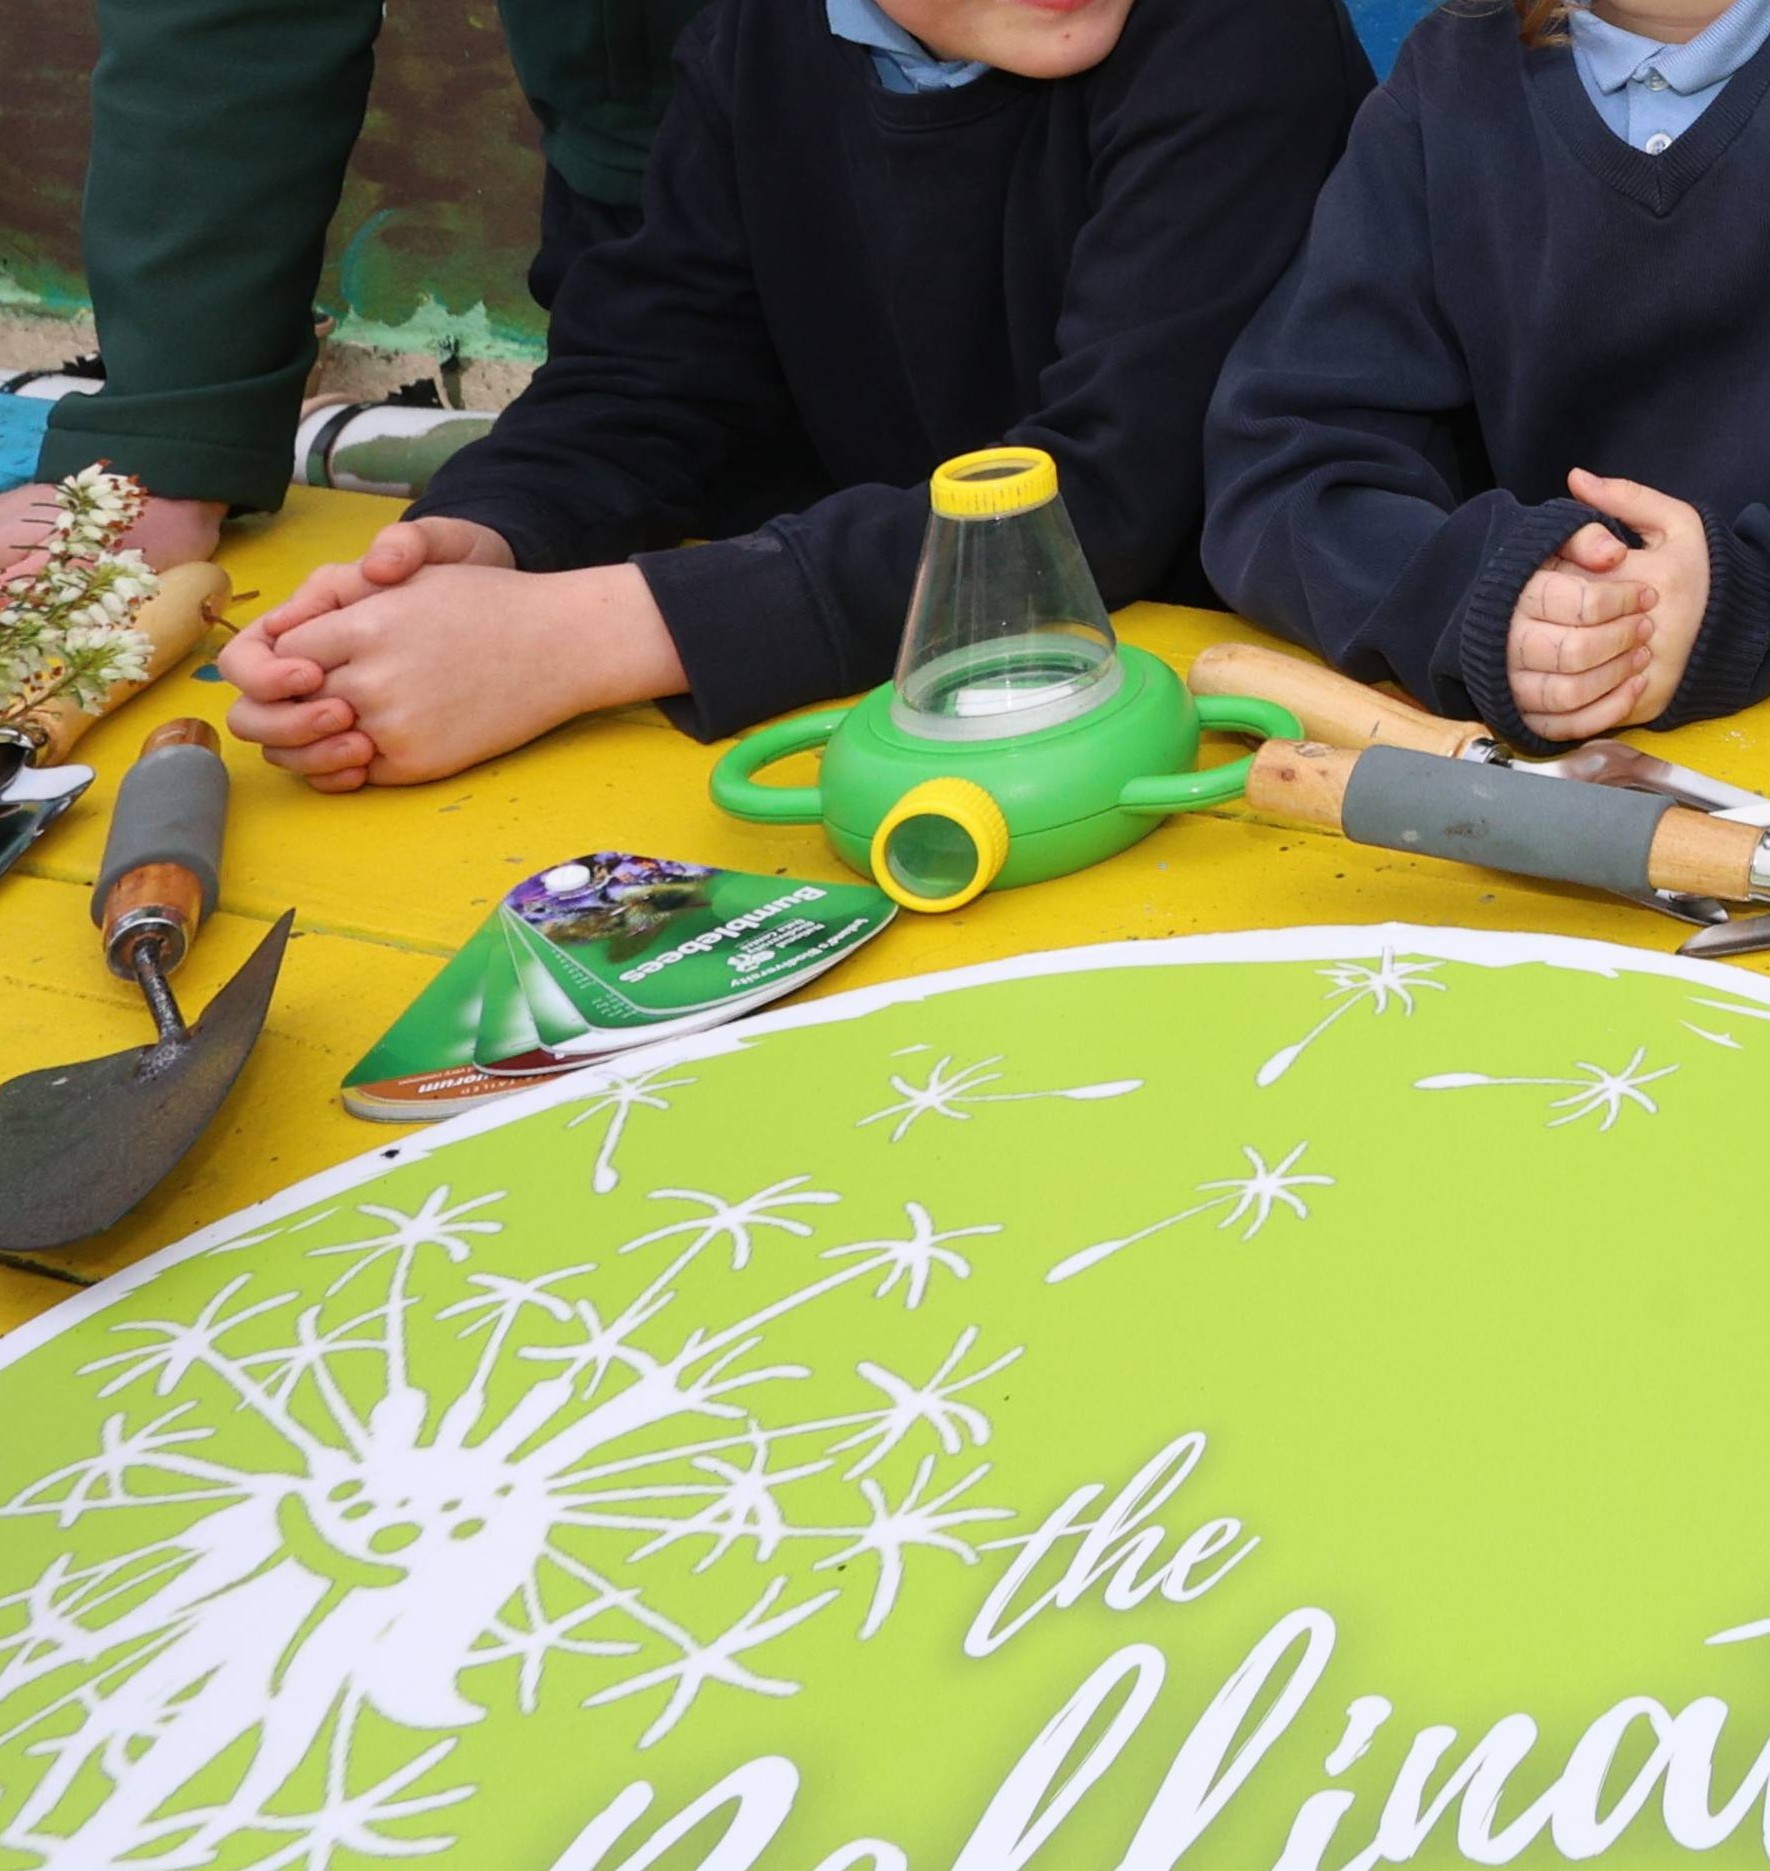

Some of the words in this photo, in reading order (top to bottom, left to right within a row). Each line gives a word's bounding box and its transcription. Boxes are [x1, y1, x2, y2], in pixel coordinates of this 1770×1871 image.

[618, 885, 828, 984] Bumblebees
[729, 945, 824, 989] Biodiversity
[963, 1430, 1262, 1658] the
